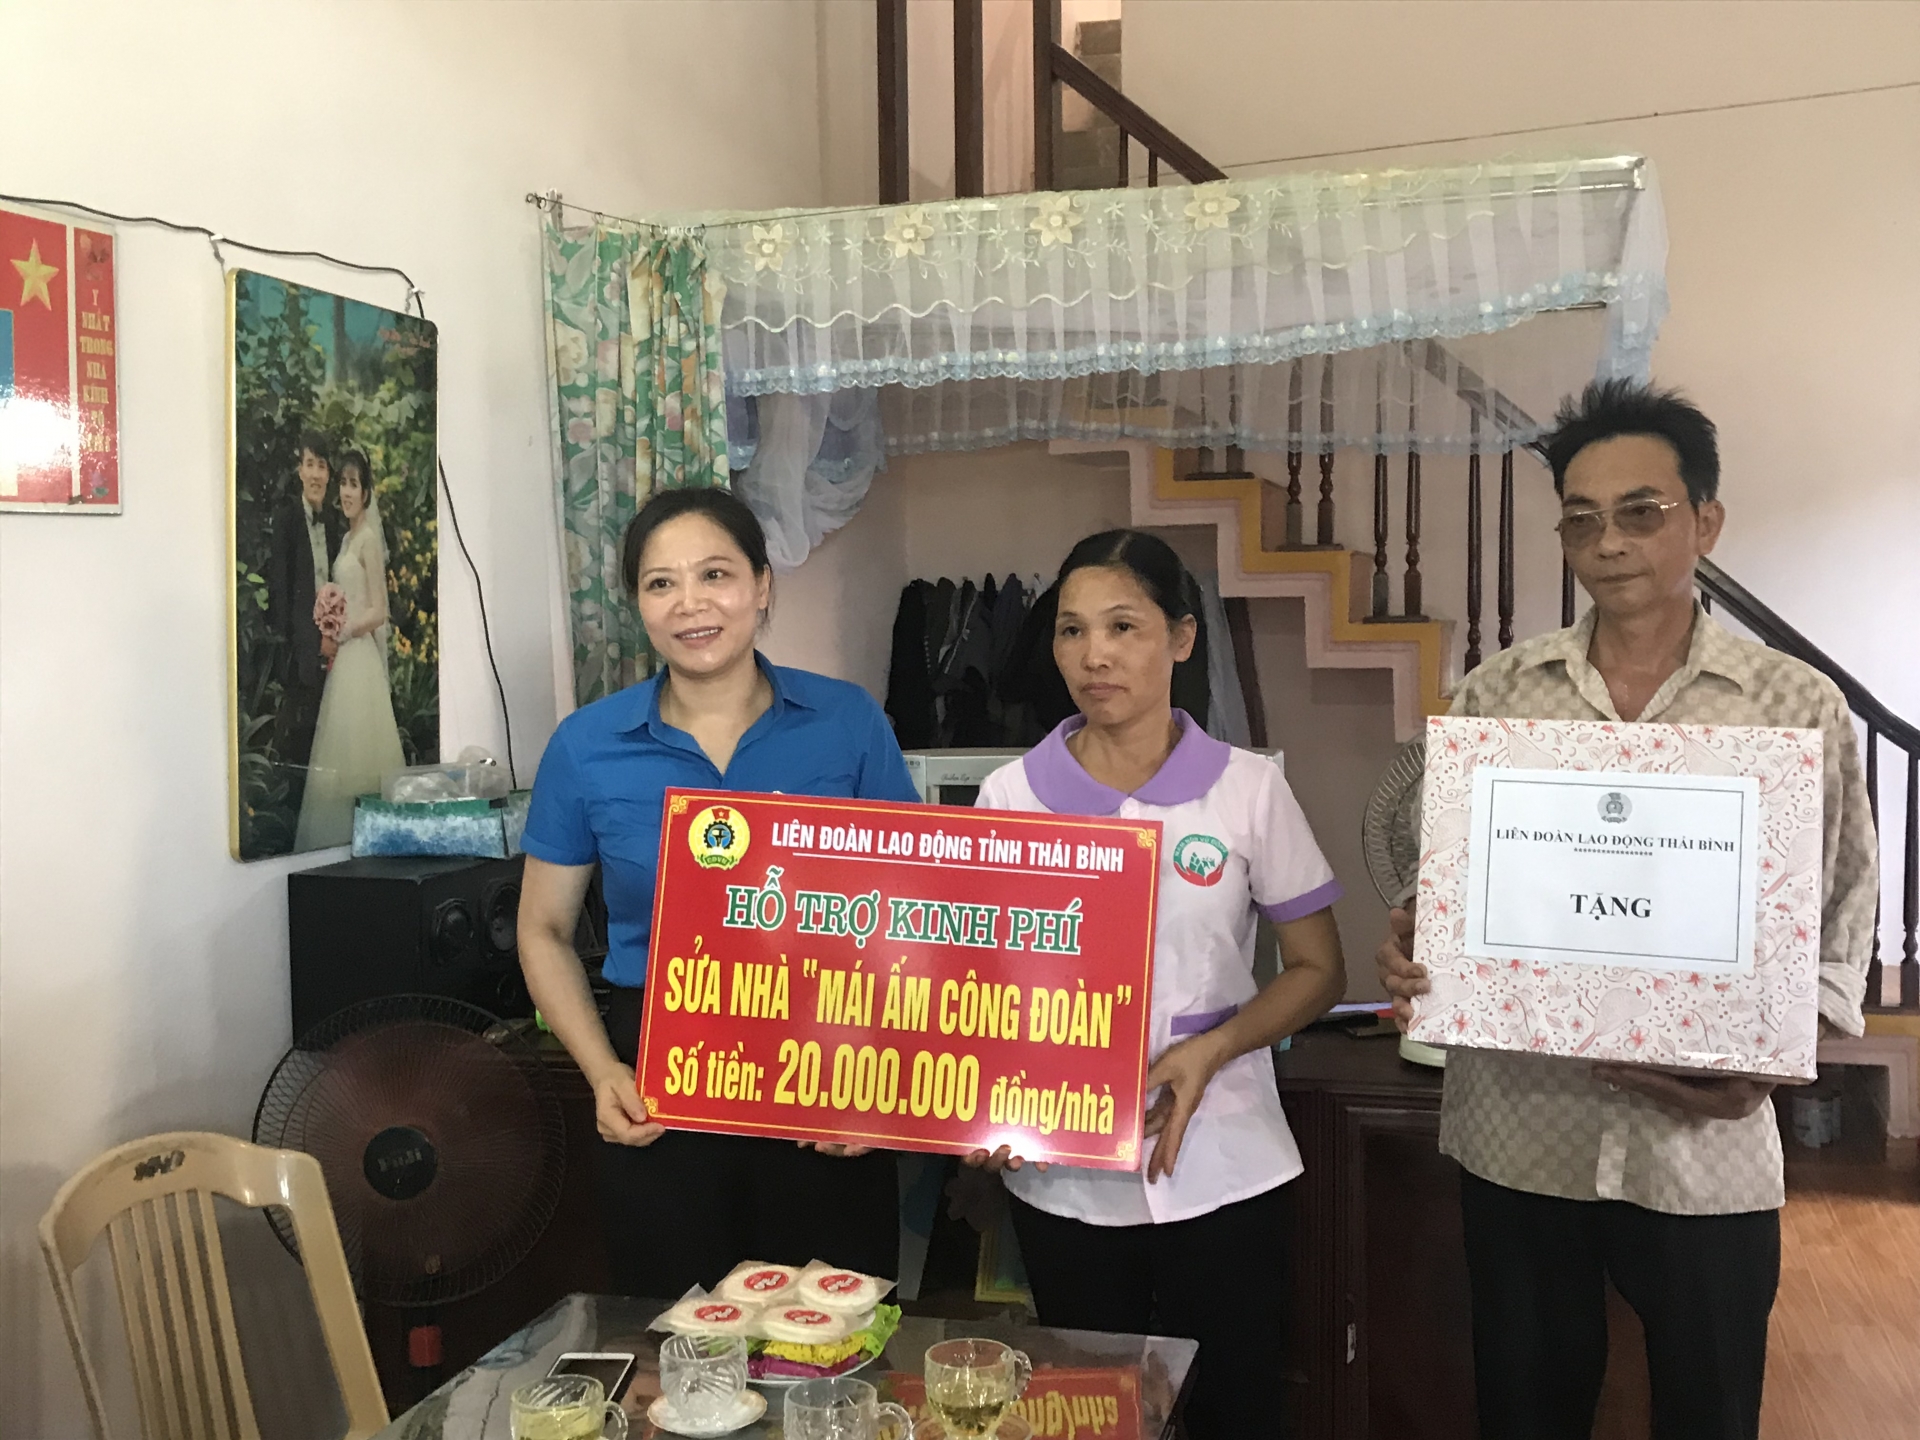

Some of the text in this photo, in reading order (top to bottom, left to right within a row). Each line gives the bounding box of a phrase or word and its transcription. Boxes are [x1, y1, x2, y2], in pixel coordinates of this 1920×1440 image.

[79, 336, 114, 356] TRONG
[771, 819, 1124, 873] LIÊN ĐOÀN LAO ĐỘNG TỈNH THÁI BÌNH
[1496, 827, 1734, 852] LIÊN ĐOÀN LAO ĐỘNG THÁI BÌNH
[723, 865, 1083, 956] HỖ TRỢ KINH PHÍ
[1569, 892, 1652, 921] TẶNG
[664, 935, 721, 1014] SỬA
[730, 953, 790, 1020] NHÀ
[880, 955, 932, 1032] ẤM
[939, 969, 1022, 1041] CÔNG
[665, 1039, 1115, 1135] Số tiền: 20.000.000 đồng/nhà
